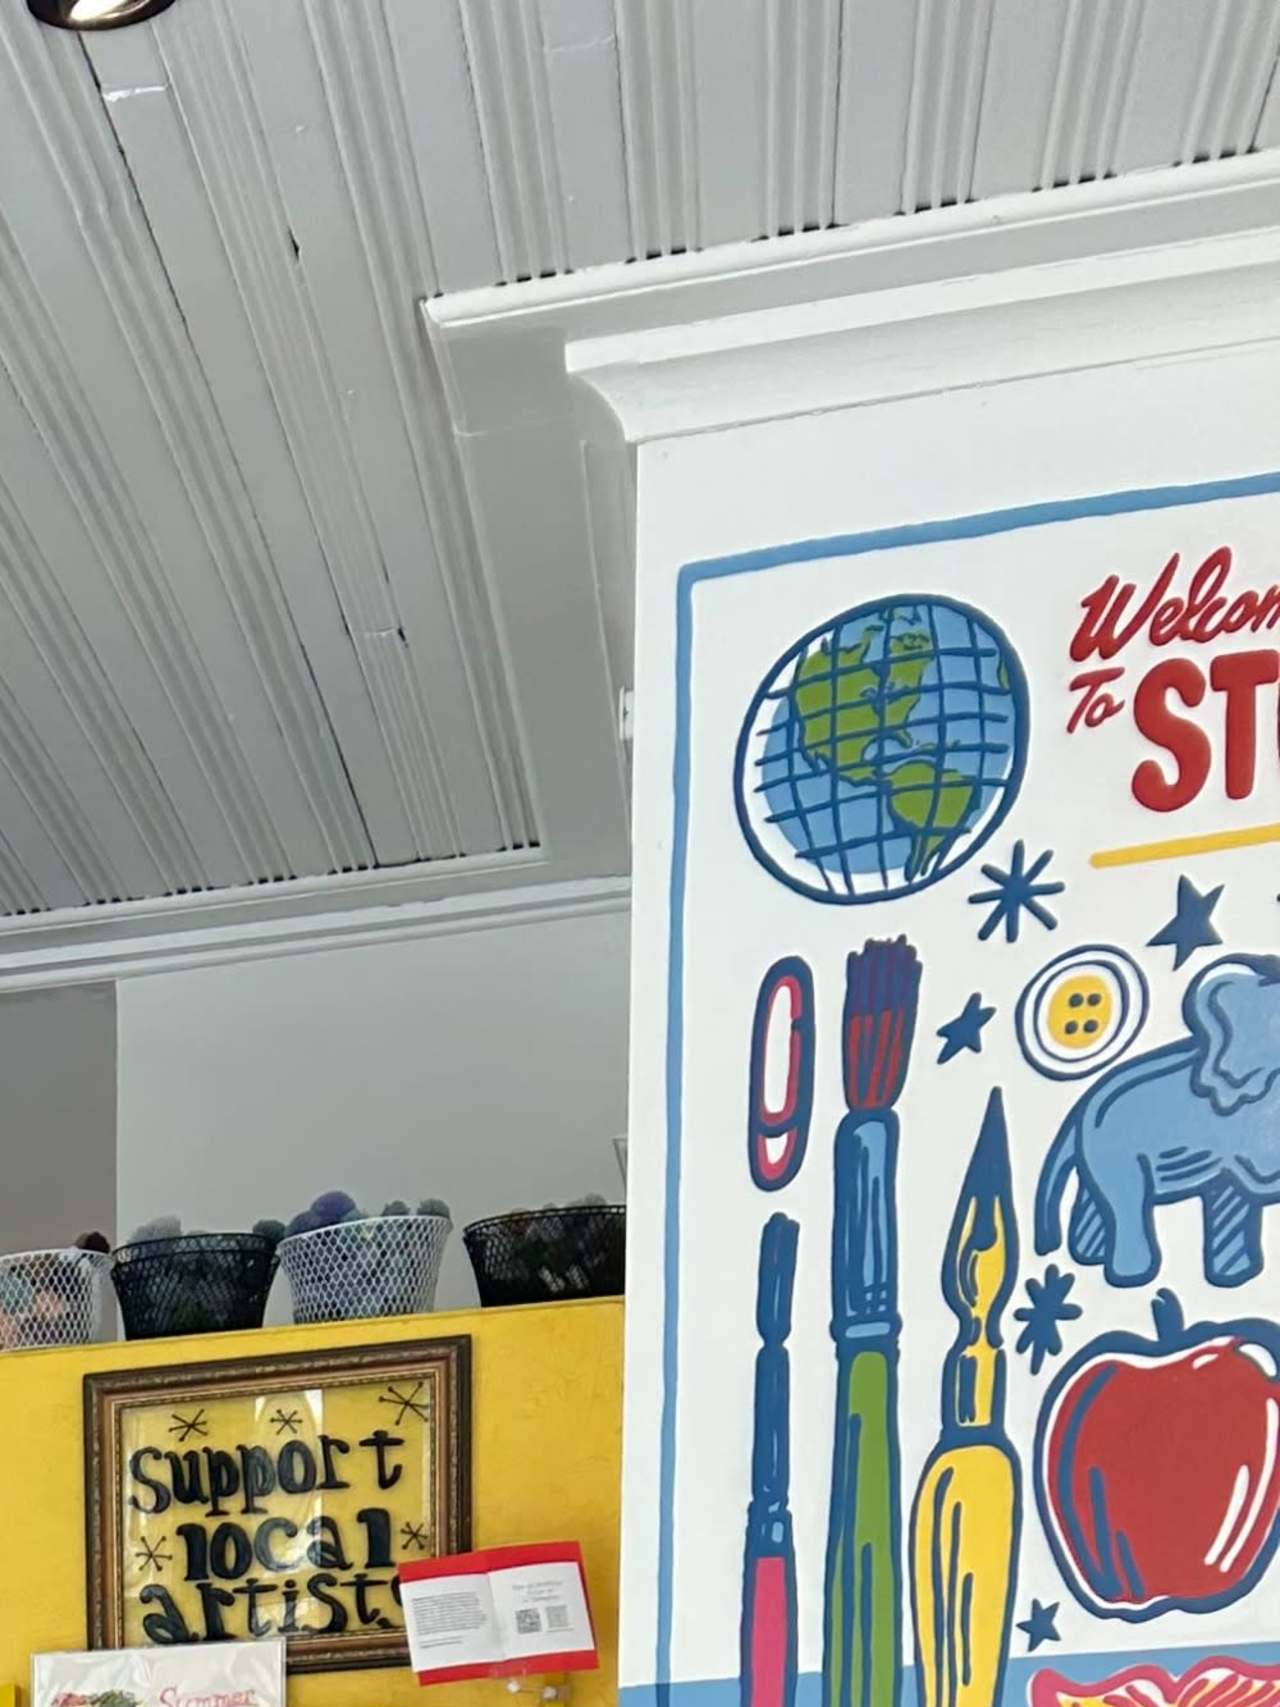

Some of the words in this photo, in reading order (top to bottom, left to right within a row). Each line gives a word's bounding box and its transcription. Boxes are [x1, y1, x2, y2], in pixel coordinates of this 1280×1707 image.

[1066, 666, 1126, 735] To
[127, 1430, 405, 1516] Support
[177, 1507, 395, 1581] local
[138, 1572, 403, 1643] artist
